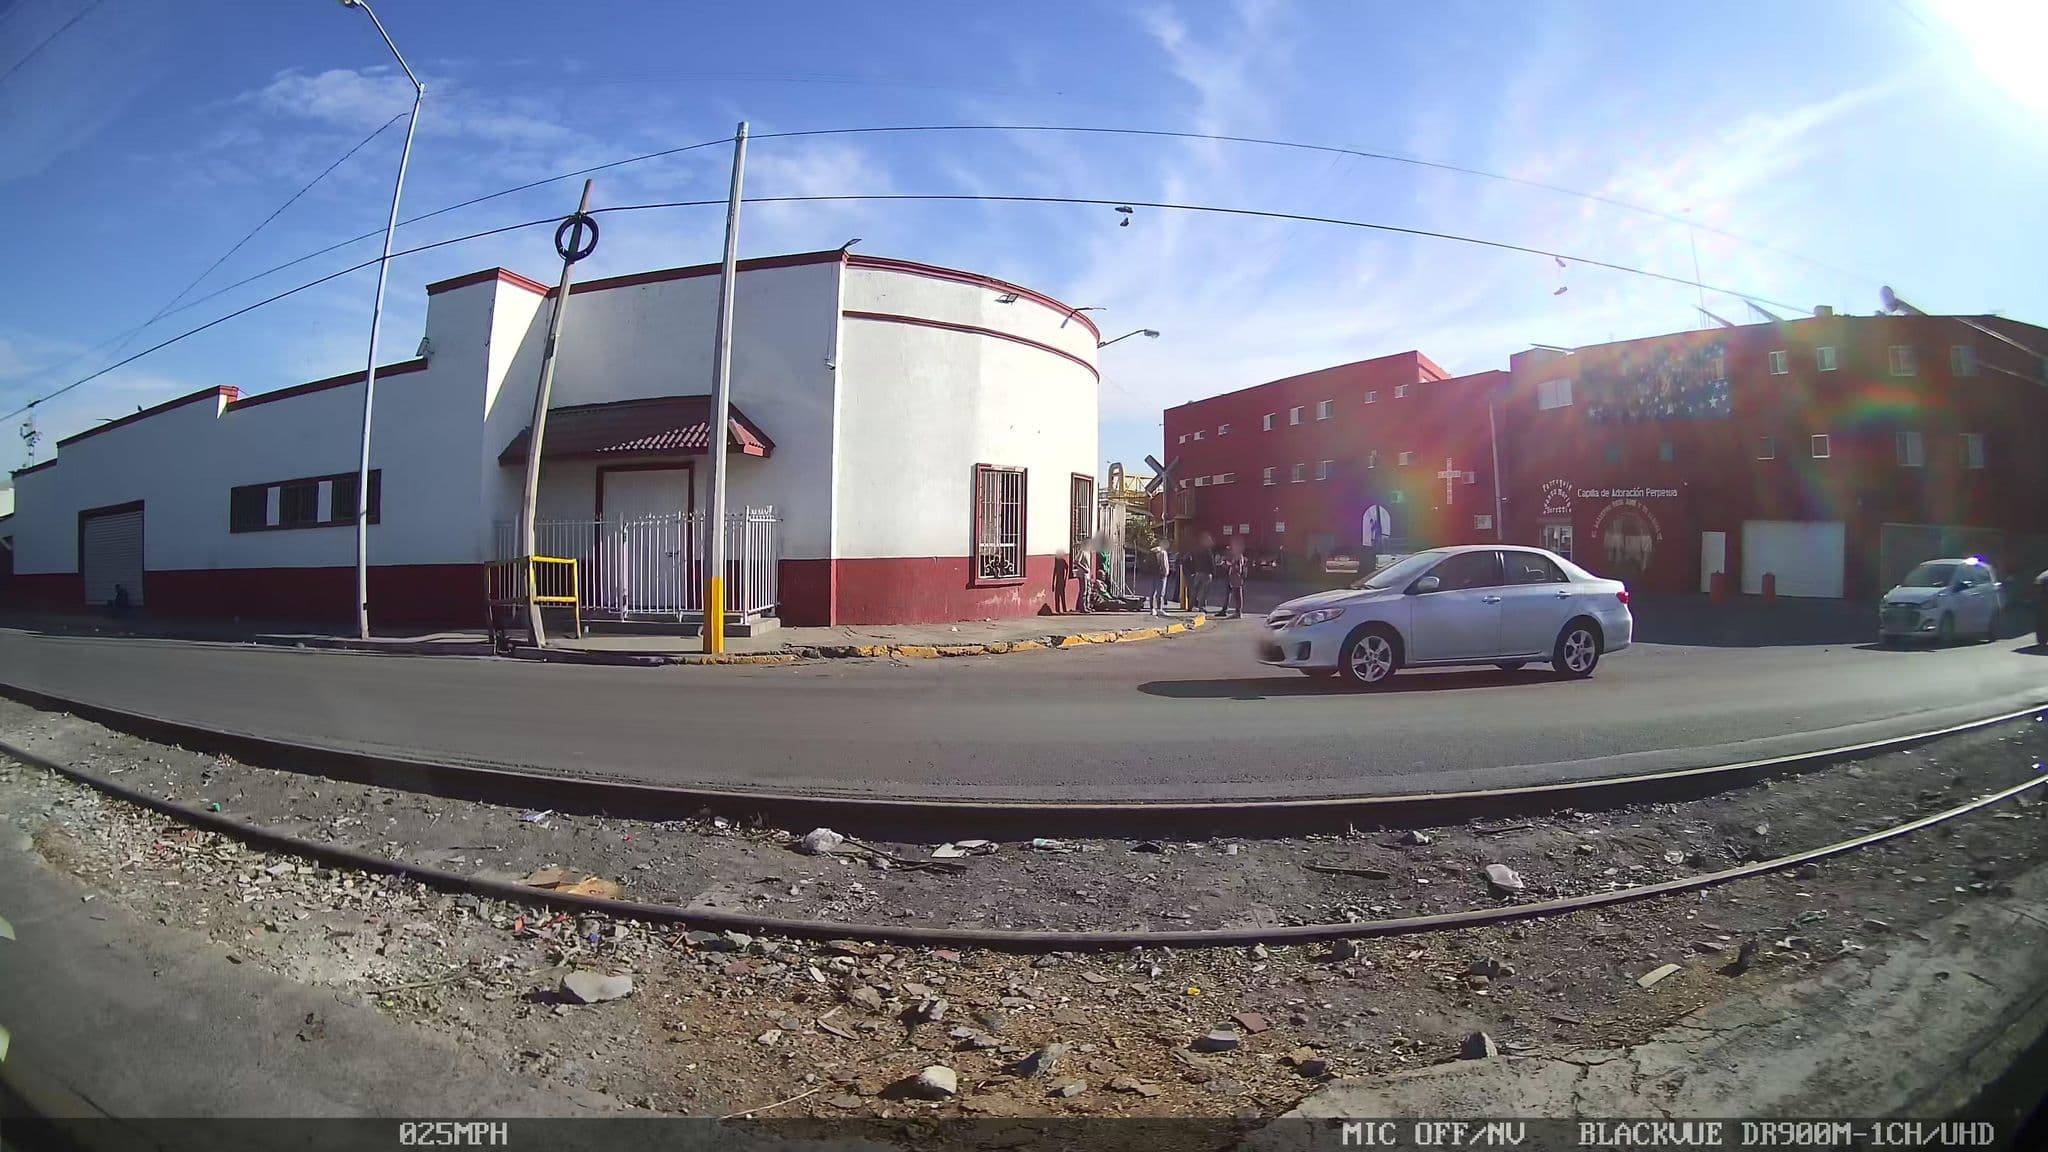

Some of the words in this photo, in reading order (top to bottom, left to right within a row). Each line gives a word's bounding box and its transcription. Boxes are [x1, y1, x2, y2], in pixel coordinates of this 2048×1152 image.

[1577, 488, 1600, 498] Capilla
[1601, 488, 1610, 497] de
[1611, 487, 1644, 498] Adoración
[1646, 488, 1678, 499] Perpetua
